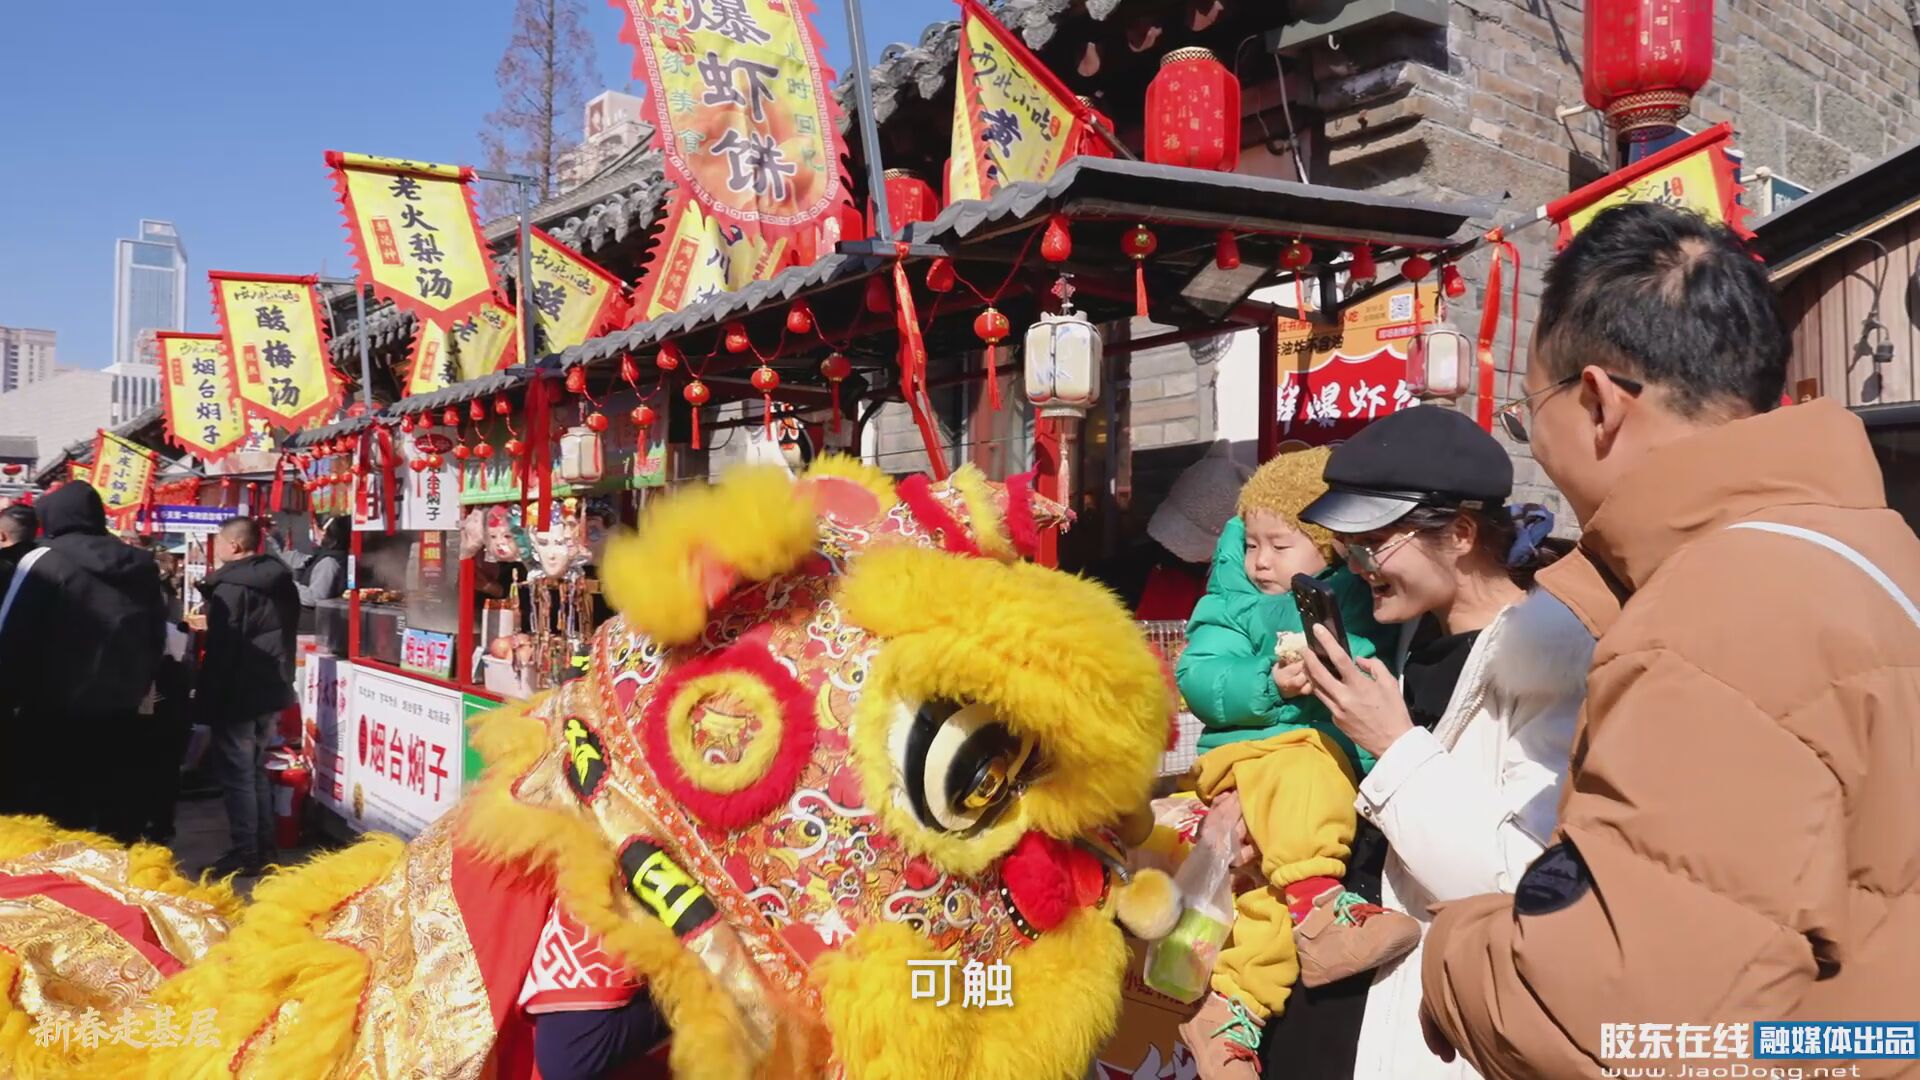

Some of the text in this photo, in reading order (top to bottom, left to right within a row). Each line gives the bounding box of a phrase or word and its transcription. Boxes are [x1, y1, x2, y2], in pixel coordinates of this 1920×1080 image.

[389, 174, 453, 300] 老火梨汤
[192, 358, 222, 445] 烟台焖子
[255, 305, 301, 406] 酸梅汤
[369, 718, 449, 802] 烟台焖子
